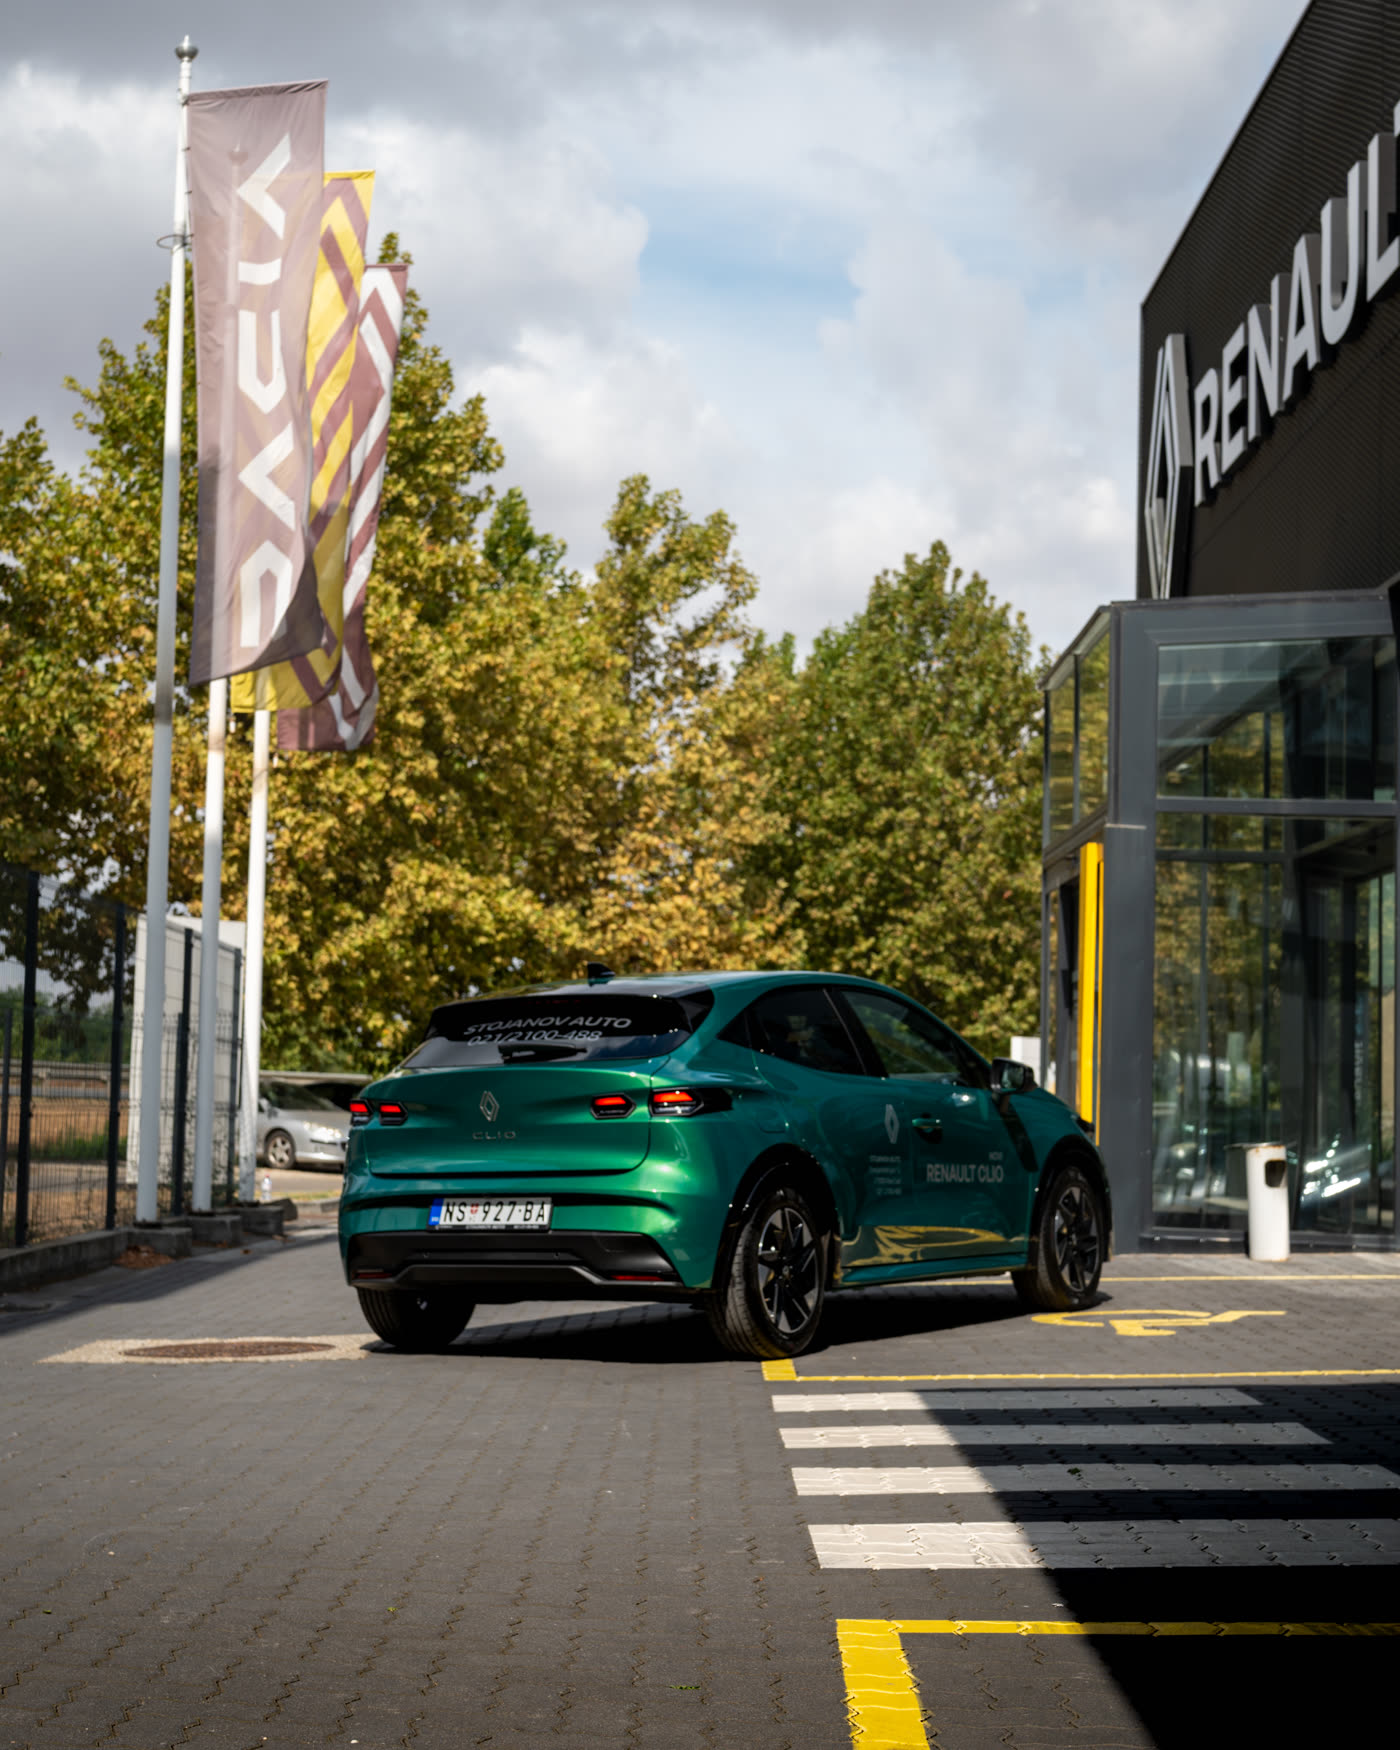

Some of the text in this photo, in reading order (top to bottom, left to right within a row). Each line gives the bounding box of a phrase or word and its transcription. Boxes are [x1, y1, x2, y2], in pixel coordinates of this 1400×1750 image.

[1193, 100, 1400, 507] RENAUL
[463, 1016, 632, 1035] STOJANOV AUTO
[472, 1131, 517, 1141] CLIO
[926, 1163, 1004, 1183] RENAULT CLIO
[444, 1201, 467, 1222] NS
